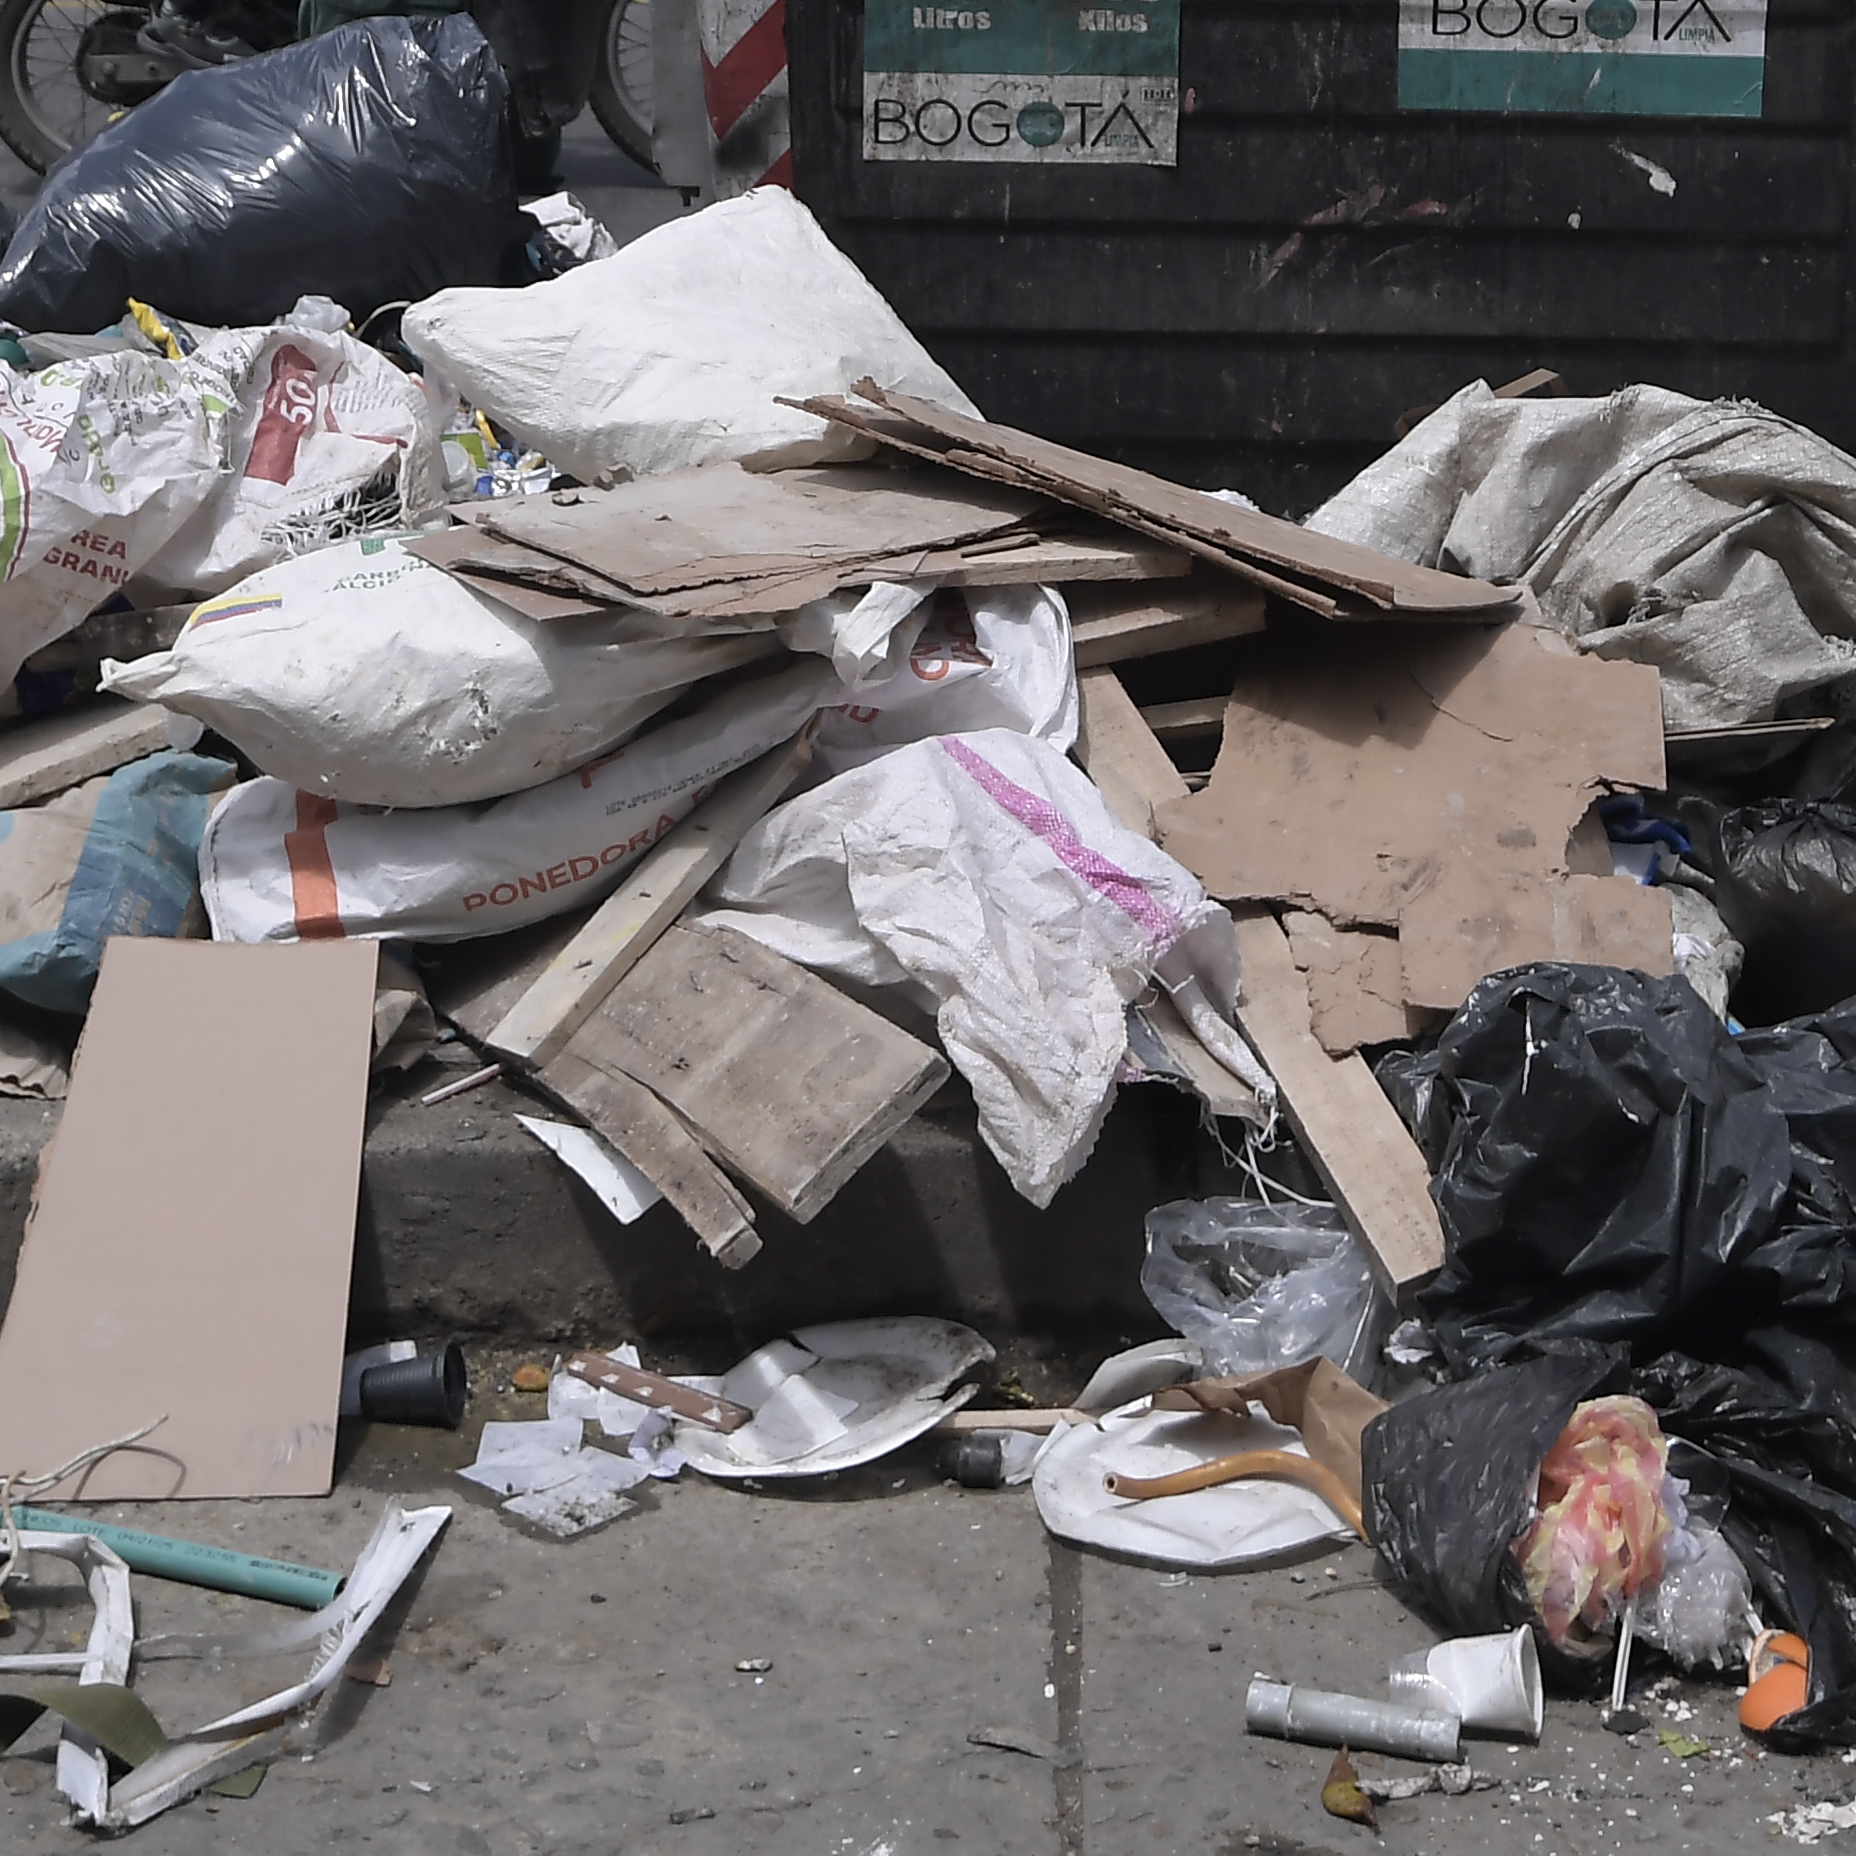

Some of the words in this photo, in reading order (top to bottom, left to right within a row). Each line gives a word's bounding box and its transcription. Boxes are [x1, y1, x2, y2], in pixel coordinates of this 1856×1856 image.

[913, 7, 992, 30] Litros
[1077, 10, 1150, 32] Kilos
[1678, 28, 1716, 42] LIMPIA
[874, 89, 1154, 148] BOGOTÁ
[1103, 133, 1140, 148] LIMPIA
[461, 812, 679, 912] PONEDORA
